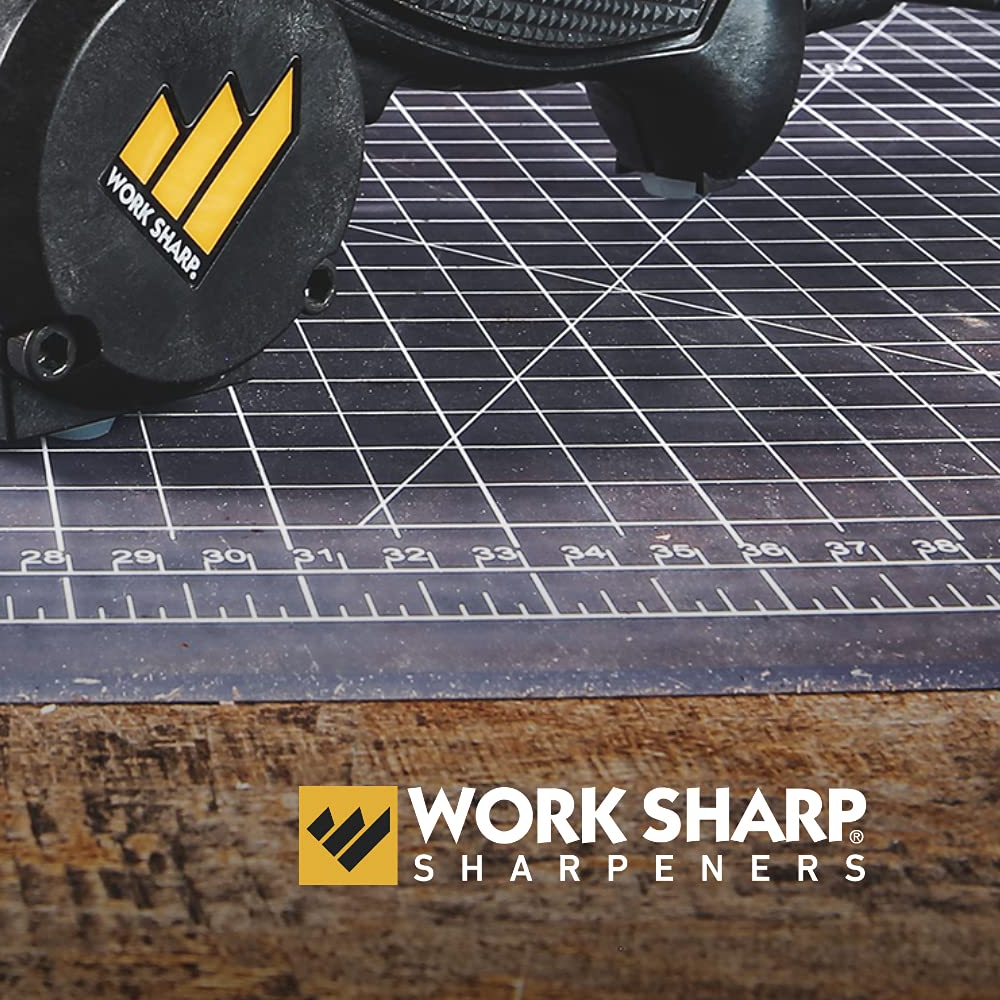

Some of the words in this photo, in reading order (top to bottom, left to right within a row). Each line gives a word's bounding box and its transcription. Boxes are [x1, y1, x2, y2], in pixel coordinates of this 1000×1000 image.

[106, 165, 155, 227] WORK
[19, 549, 67, 565] 28
[110, 549, 158, 565] 29
[201, 548, 248, 564] 30
[291, 548, 334, 563] 31
[381, 547, 430, 563] 32
[471, 546, 520, 562] 33
[559, 544, 607, 560] 34
[649, 544, 698, 559] 35
[738, 542, 786, 557] 36
[823, 540, 867, 556] 37
[910, 539, 961, 555] 38
